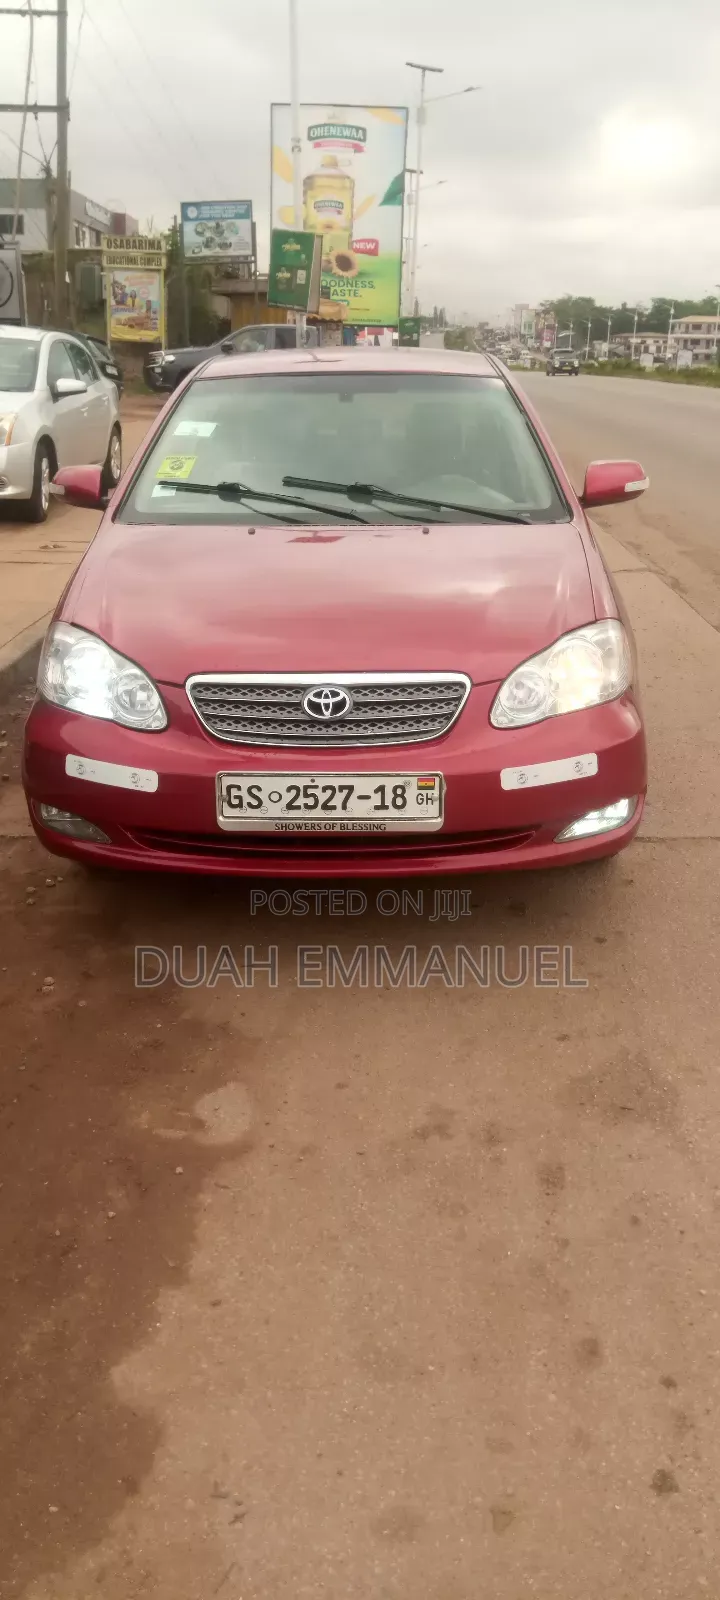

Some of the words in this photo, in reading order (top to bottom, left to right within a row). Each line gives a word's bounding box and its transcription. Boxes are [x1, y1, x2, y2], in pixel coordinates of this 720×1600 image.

[310, 126, 363, 140] OHENEWAA
[106, 238, 162, 250] OSABARIMA
[352, 242, 376, 250] NEW
[321, 279, 375, 289] OODNESS,
[331, 288, 362, 297] ASTE.
[225, 784, 263, 810] GS
[285, 784, 408, 811] 2527-18
[416, 792, 435, 806] GH
[274, 822, 322, 832] SHOWERS
[324, 822, 337, 831] OF
[339, 823, 387, 832] BLESSING
